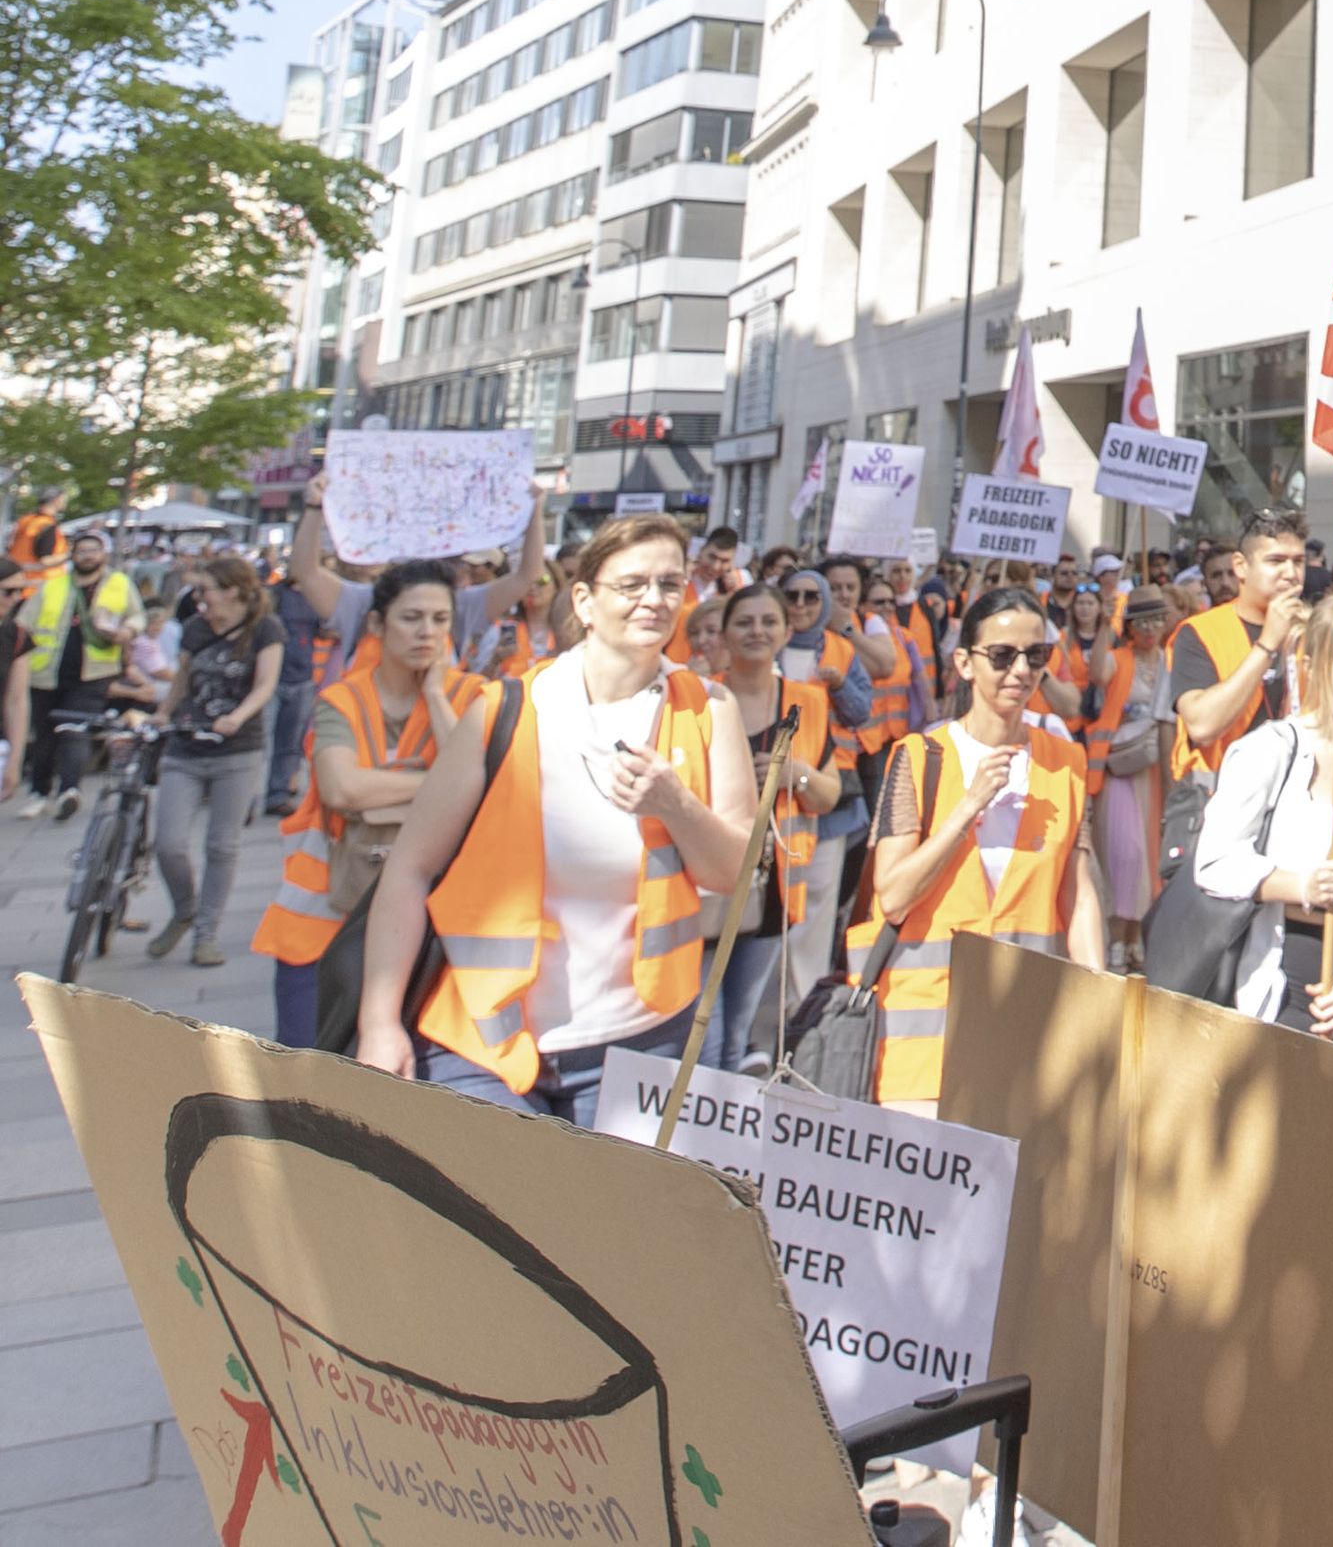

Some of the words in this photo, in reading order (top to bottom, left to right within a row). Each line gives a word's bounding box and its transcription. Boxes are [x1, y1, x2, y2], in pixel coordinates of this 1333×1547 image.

[868, 446, 894, 465] SO
[1108, 438, 1133, 460] SO
[1135, 444, 1199, 474] NICHT!
[983, 484, 1051, 507] FREIZEIT-
[967, 505, 1057, 533] PÄDAGOGIK
[978, 533, 1037, 556] BLEIBT!
[771, 1113, 981, 1197] SPIELFIGUR,
[775, 1178, 936, 1240] BAUERN-
